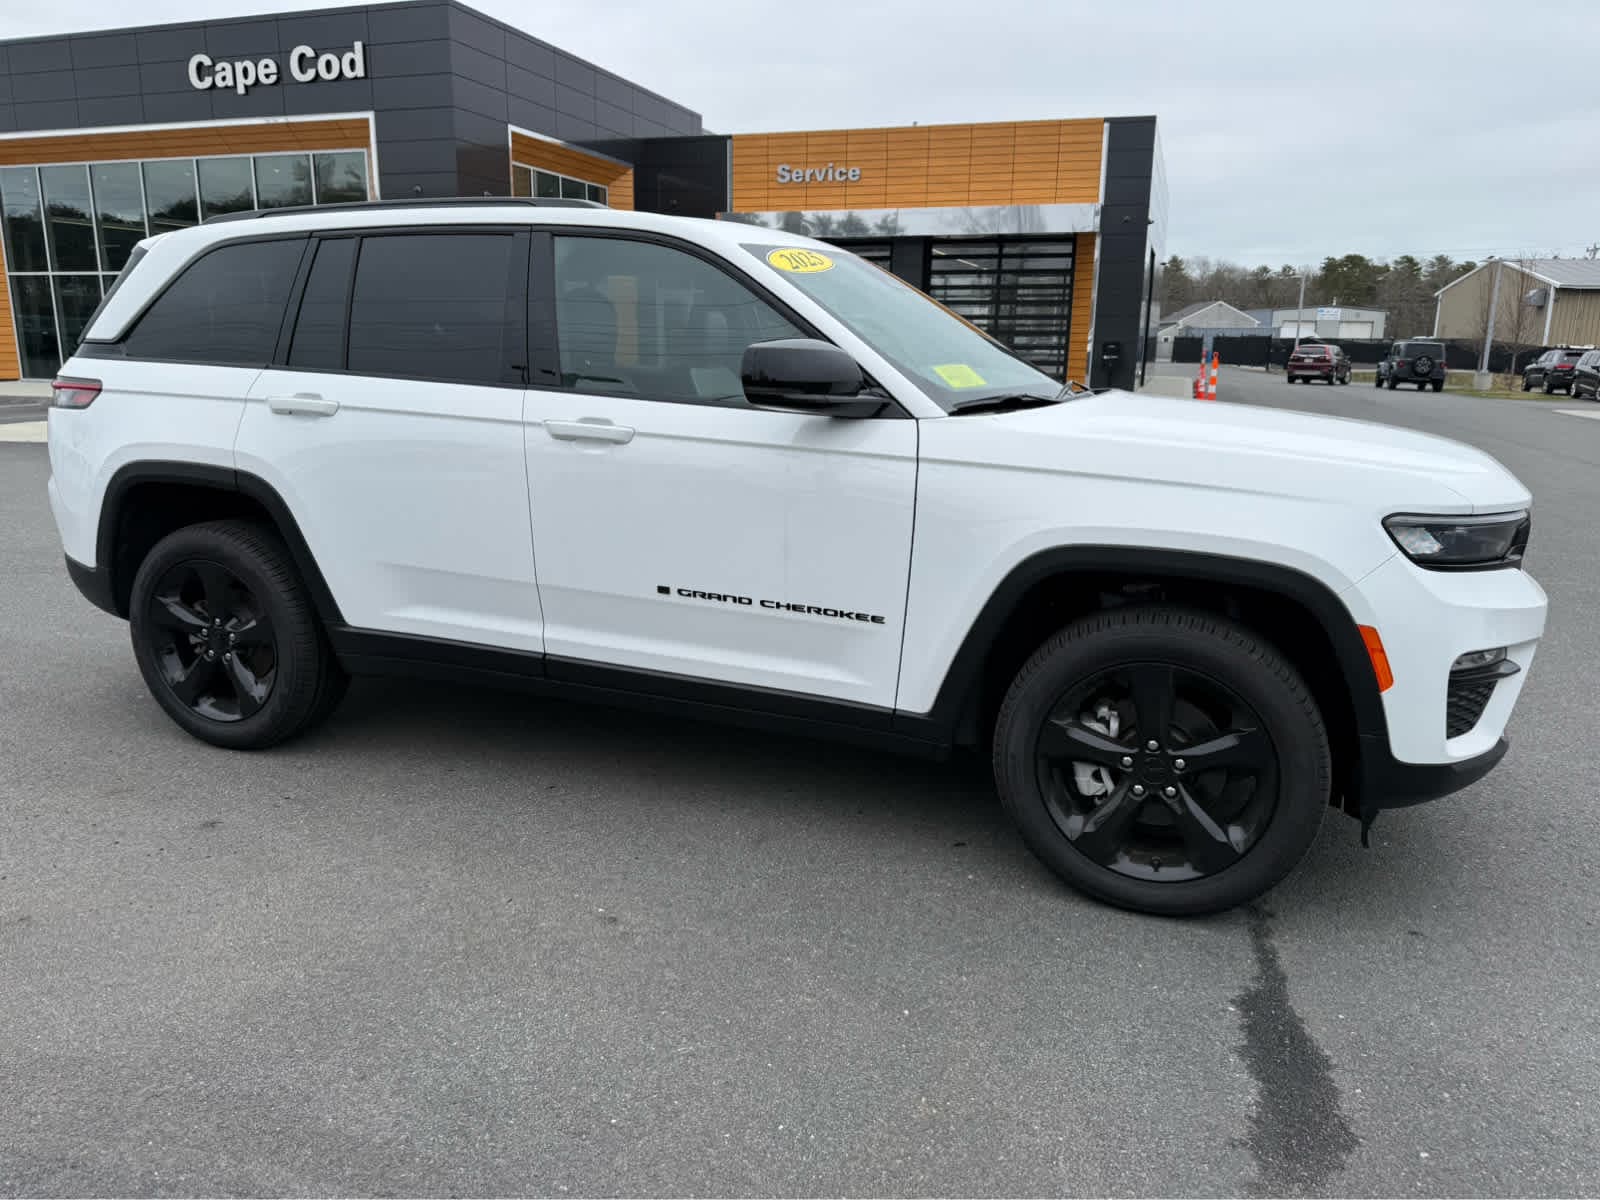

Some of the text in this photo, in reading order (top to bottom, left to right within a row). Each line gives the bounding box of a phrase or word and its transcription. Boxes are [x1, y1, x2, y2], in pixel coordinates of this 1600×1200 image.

[188, 41, 366, 95] Cape Cod
[776, 162, 861, 184] Service
[780, 251, 825, 270] 2025
[677, 587, 886, 625] GRAND CHEROKEE
